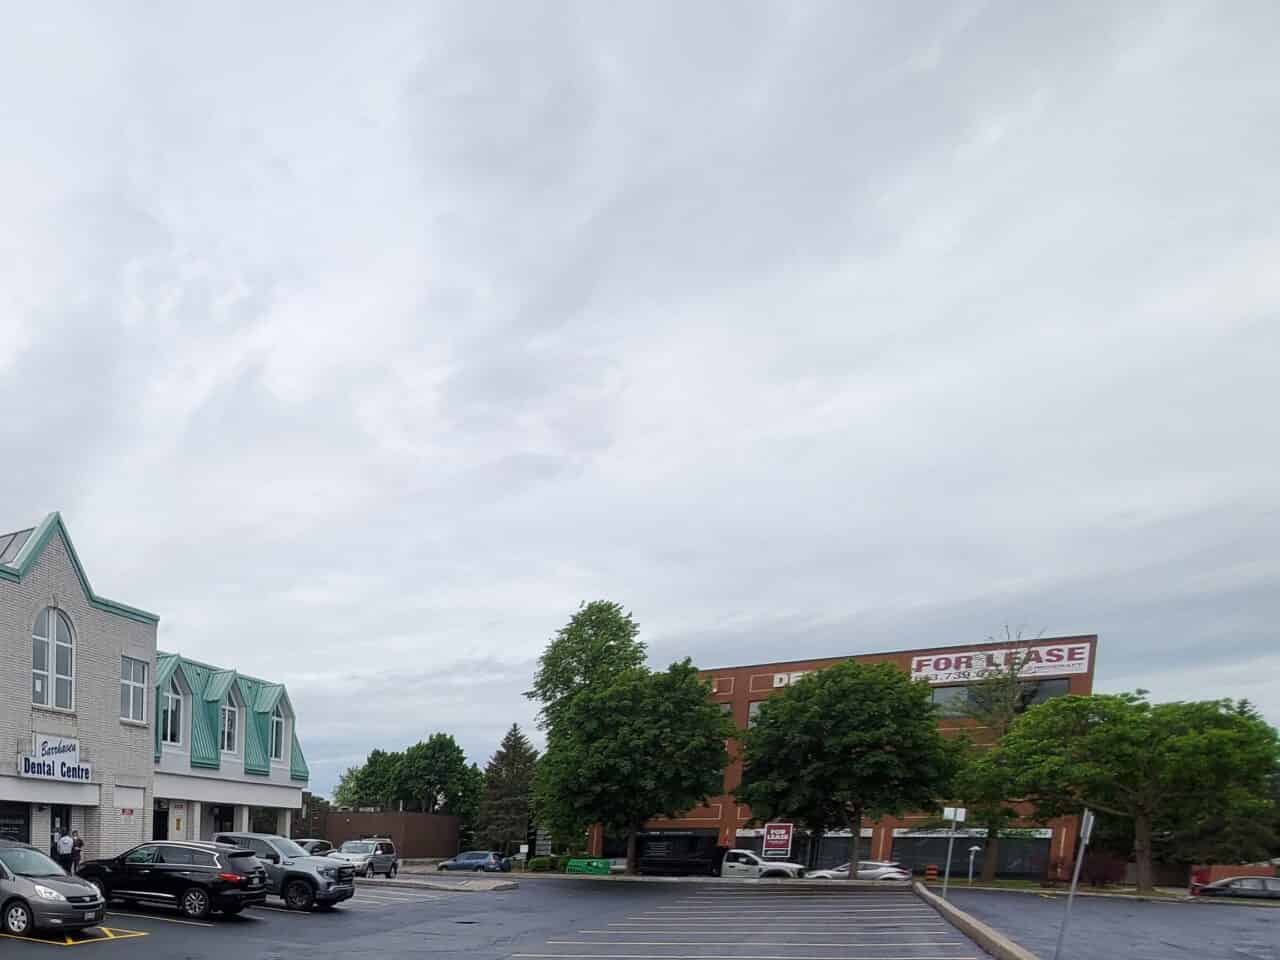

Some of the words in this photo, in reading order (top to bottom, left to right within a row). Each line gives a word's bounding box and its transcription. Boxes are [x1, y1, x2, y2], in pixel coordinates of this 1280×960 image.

[914, 655, 974, 673] FOR
[985, 646, 1086, 669] LEASE
[23, 757, 55, 777] Dental
[60, 761, 90, 780] Centre
